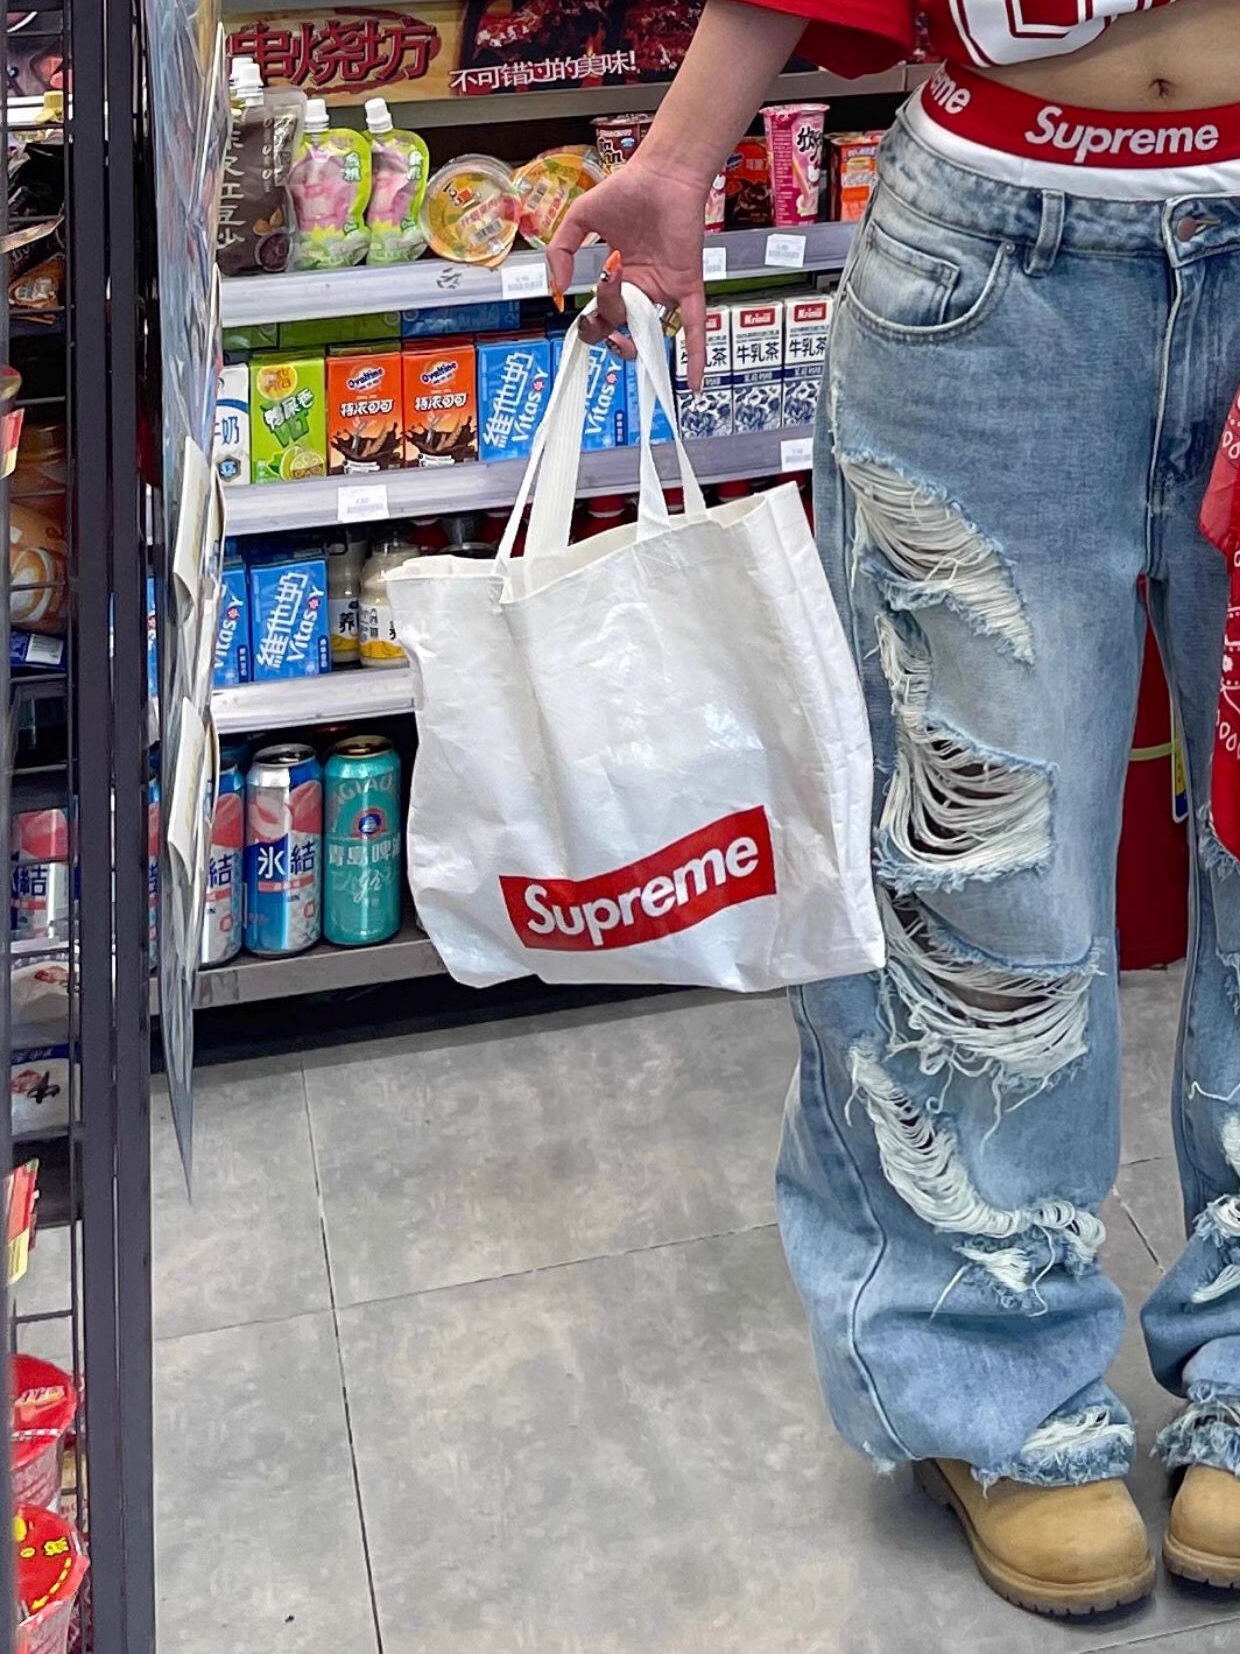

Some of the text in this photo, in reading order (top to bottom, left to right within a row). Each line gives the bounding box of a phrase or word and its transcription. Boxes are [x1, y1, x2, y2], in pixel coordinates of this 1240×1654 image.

[229, 22, 440, 87] 串烧坊
[450, 50, 638, 93] 不可错过的美味!
[1025, 106, 1220, 168] Supreme
[420, 360, 458, 386] Ovaltine
[736, 342, 781, 365] 牛乳茶
[789, 336, 828, 359] 牛乳茶
[483, 352, 534, 449] 維他奶
[256, 571, 308, 670] 維他奶
[525, 837, 760, 944] Supreme
